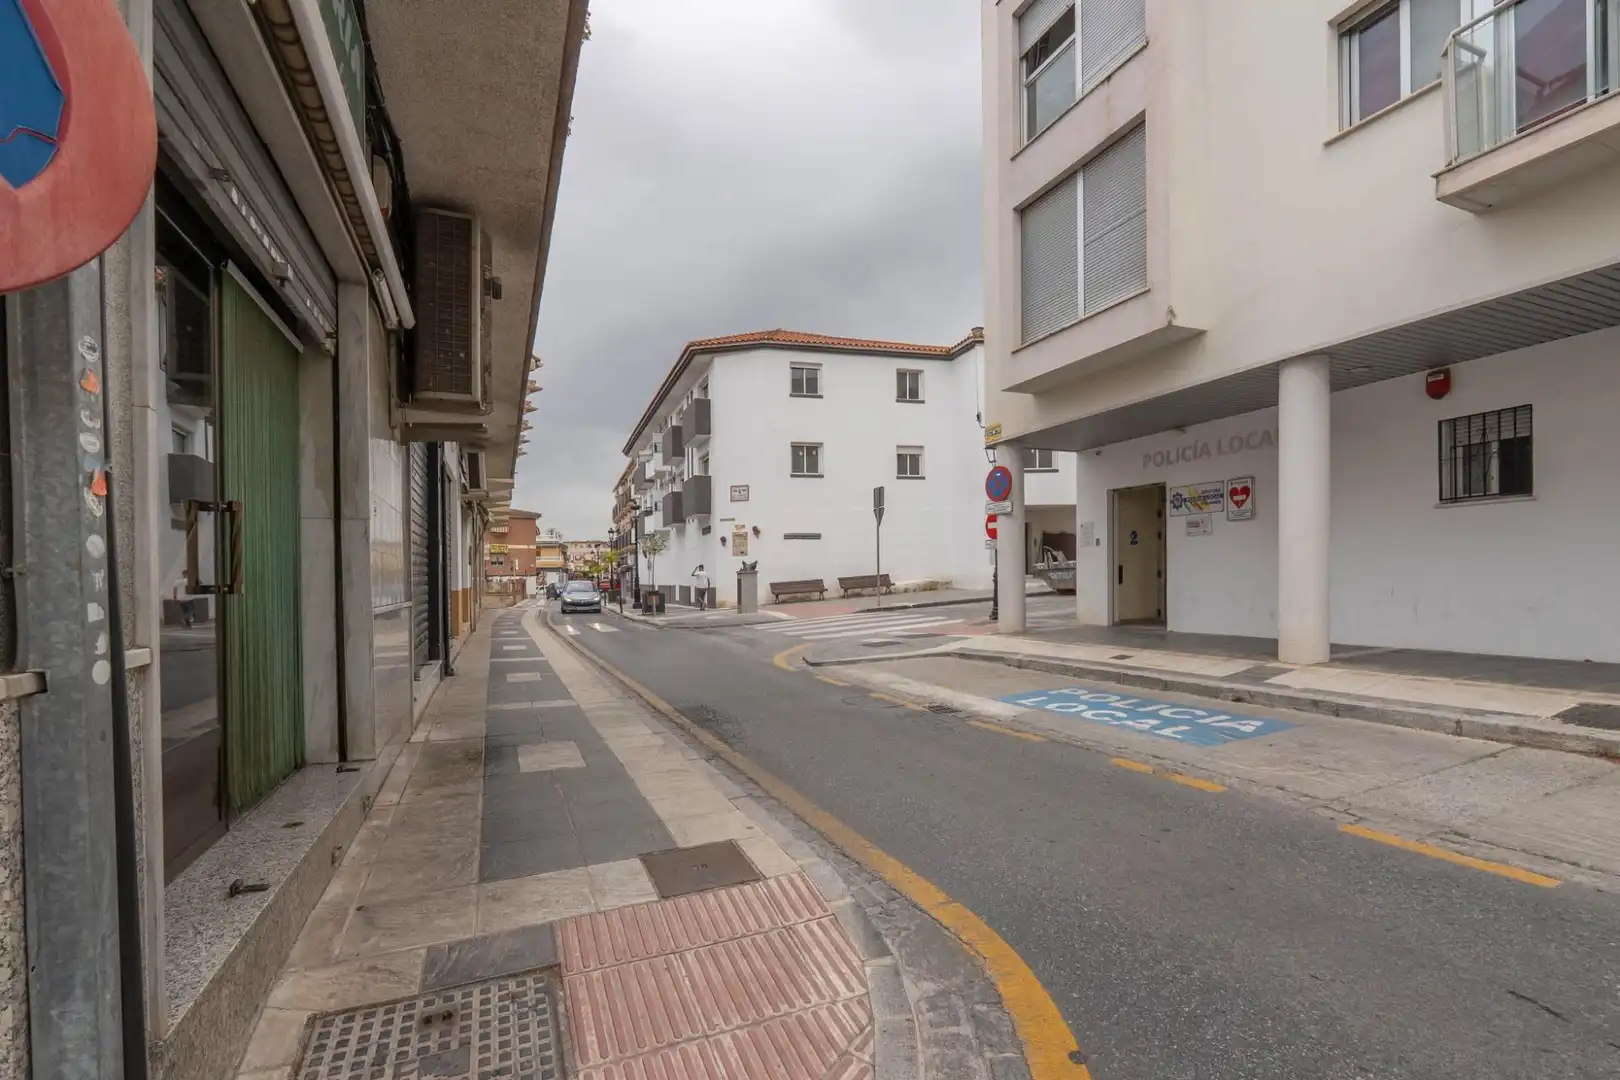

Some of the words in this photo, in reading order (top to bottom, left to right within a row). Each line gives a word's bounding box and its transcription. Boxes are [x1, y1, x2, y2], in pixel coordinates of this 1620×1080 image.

[1142, 439, 1212, 469] POLICÍA
[1217, 429, 1277, 455] LOCA
[1015, 696, 1192, 739] LOCAL
[1048, 687, 1264, 733] POLICIA
